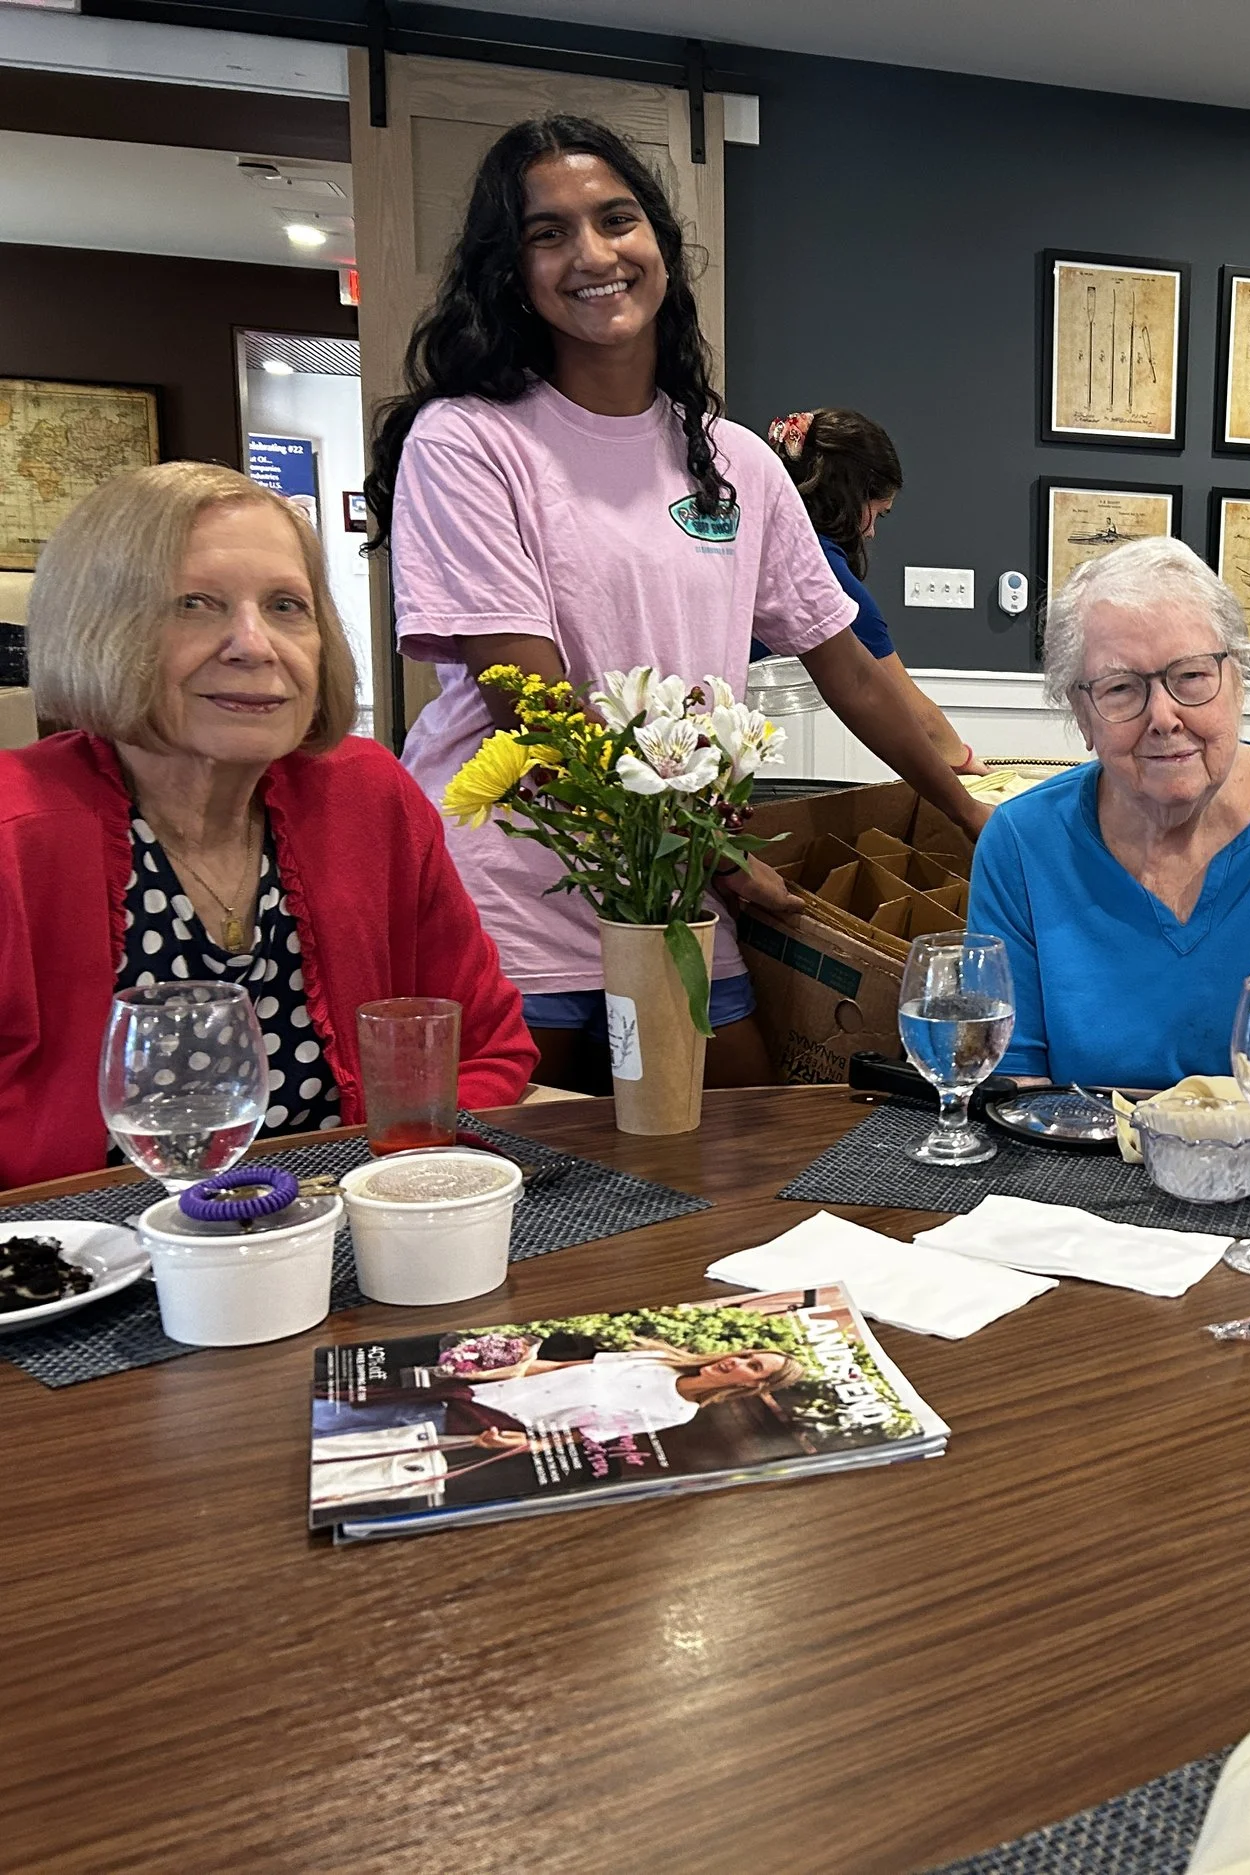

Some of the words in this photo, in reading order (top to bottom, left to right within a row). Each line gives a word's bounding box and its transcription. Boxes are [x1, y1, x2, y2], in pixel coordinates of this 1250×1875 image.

[249, 441, 287, 455] elebrating
[249, 464, 281, 473] ompanies
[250, 472, 279, 481] ndustries
[789, 1031, 846, 1070] BANANAS
